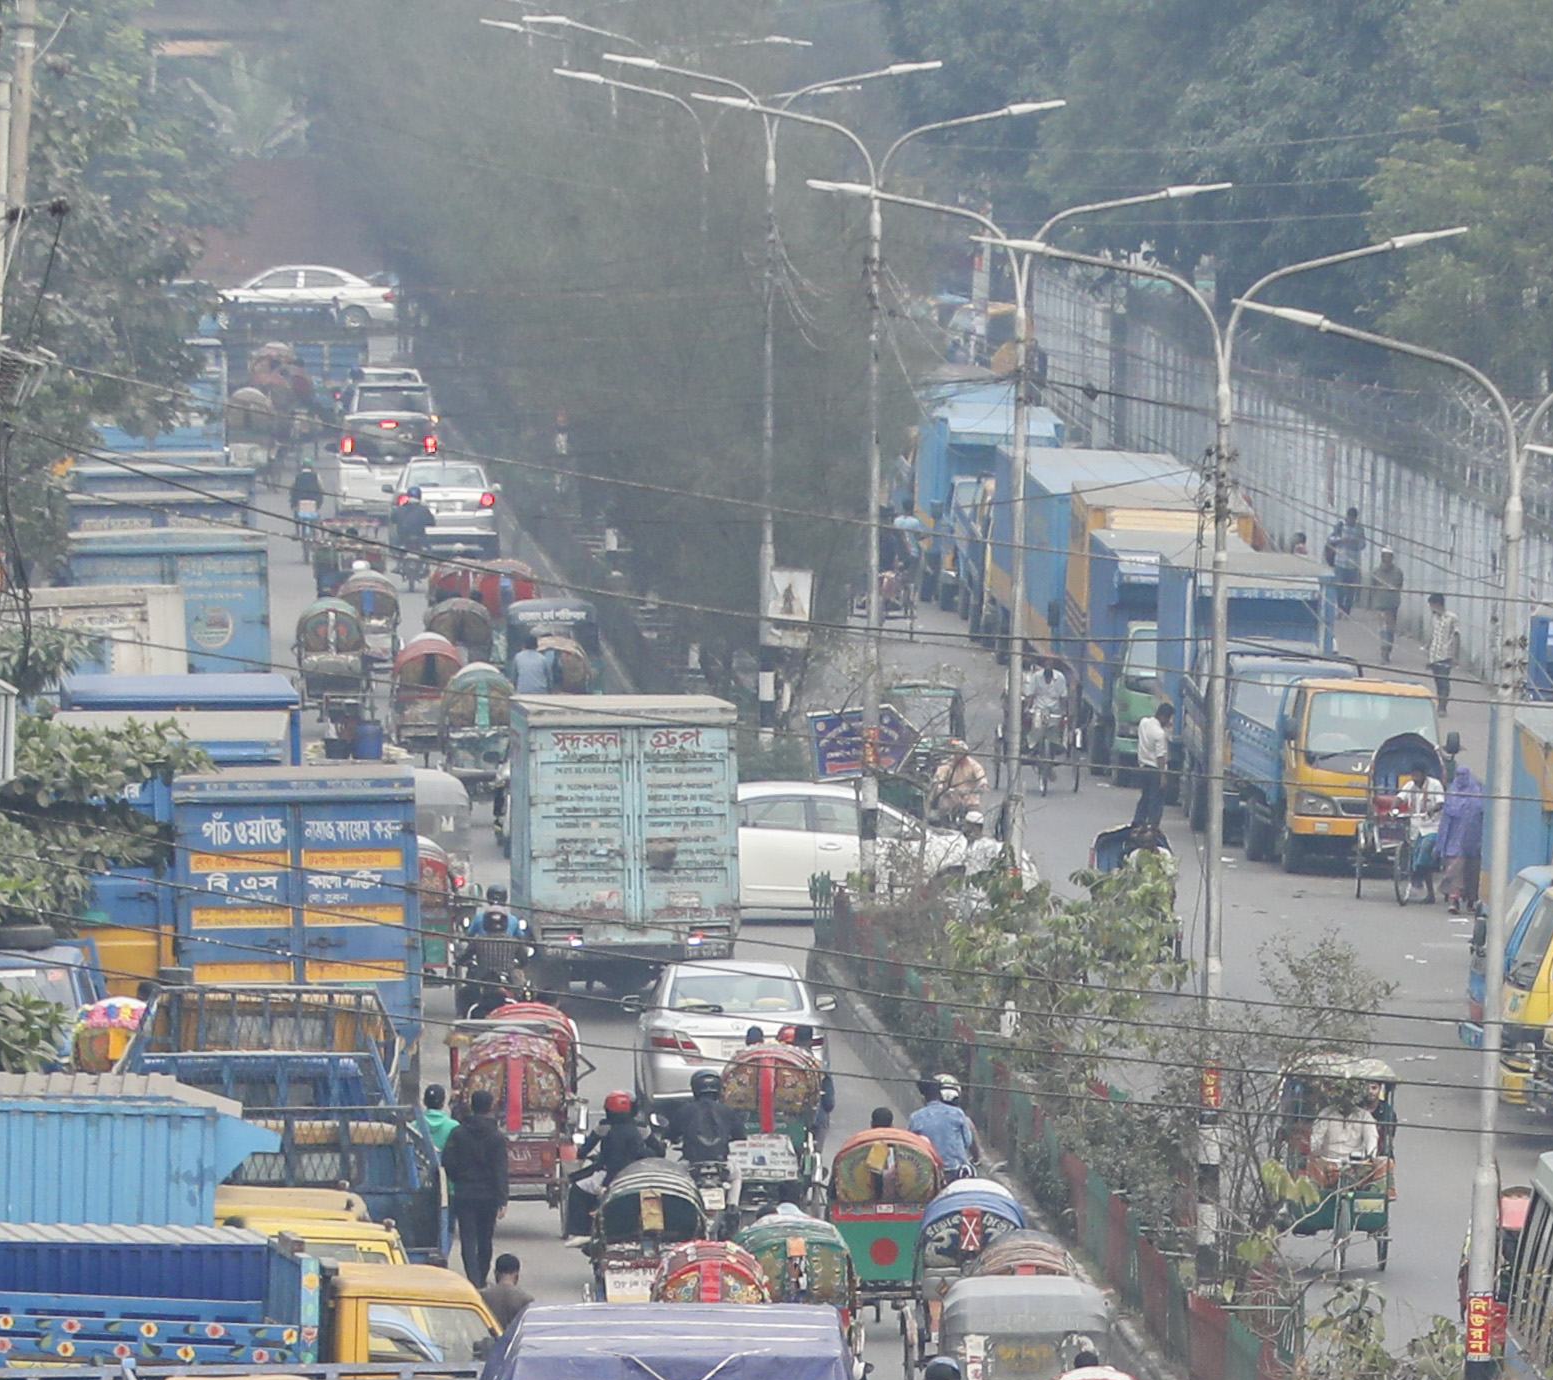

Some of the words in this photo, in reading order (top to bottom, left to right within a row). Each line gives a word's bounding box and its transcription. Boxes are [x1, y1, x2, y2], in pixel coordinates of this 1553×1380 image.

[551, 731, 619, 751] সুন্দরবন
[650, 729, 703, 748] গ্রুপ
[202, 811, 231, 845] পাঁচ
[1469, 1297, 1490, 1352] নিউরন
